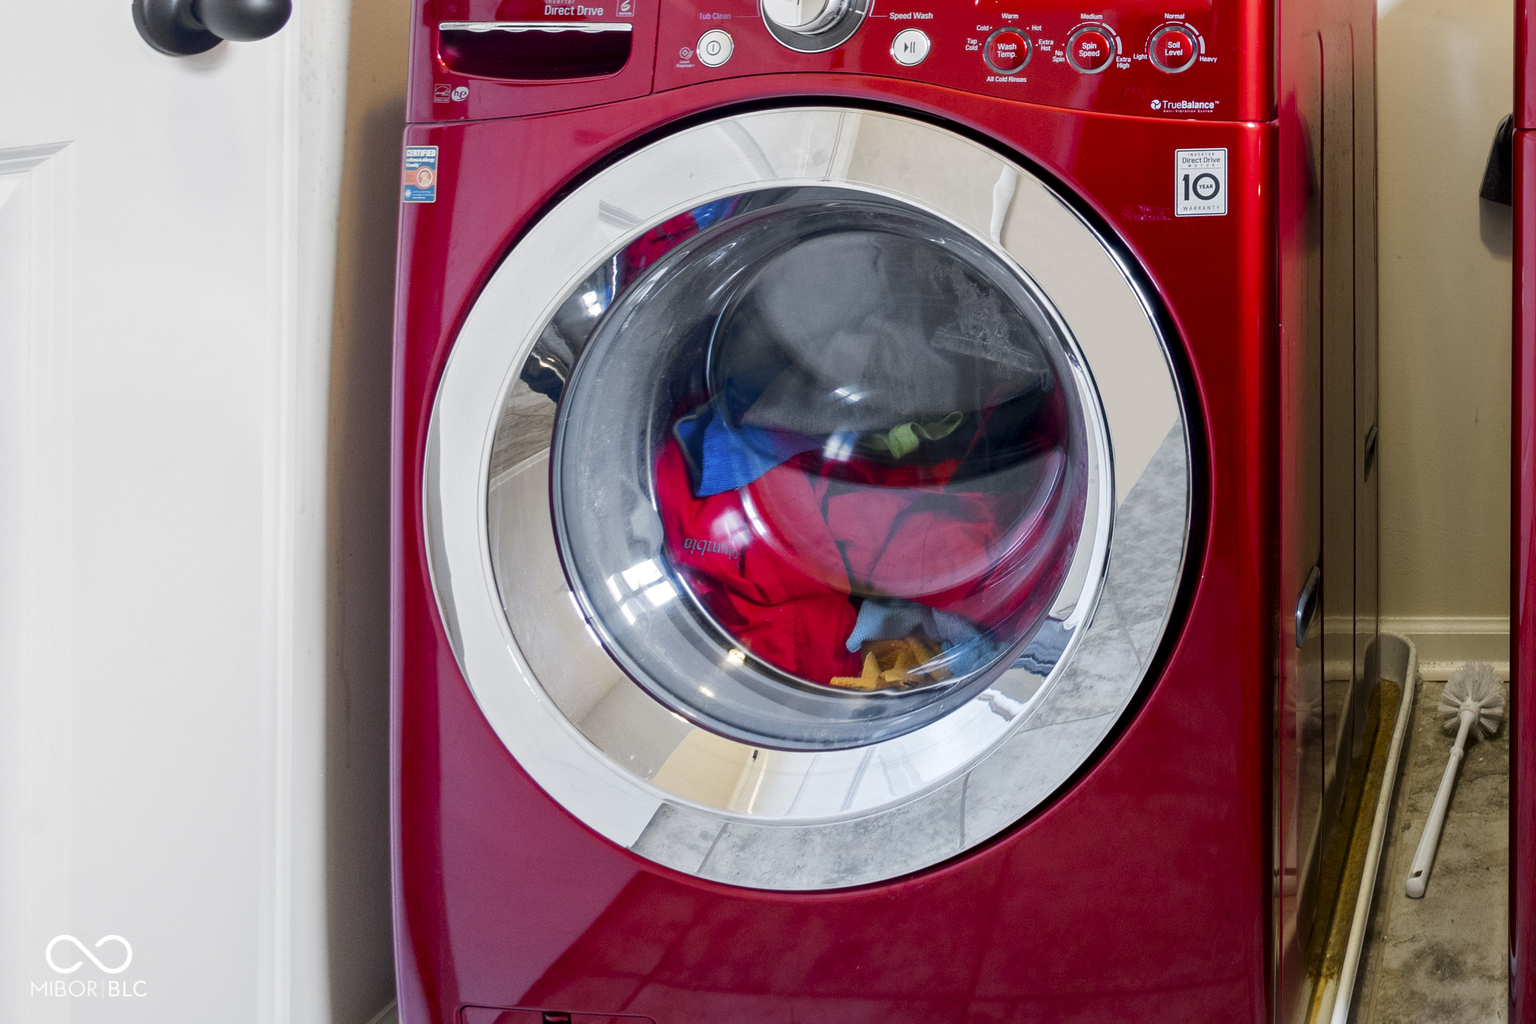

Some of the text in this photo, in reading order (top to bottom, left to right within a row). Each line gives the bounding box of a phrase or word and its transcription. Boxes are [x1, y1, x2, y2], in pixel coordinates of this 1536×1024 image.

[544, 4, 604, 16] Direct Drive
[889, 12, 912, 20] Speed
[1082, 42, 1097, 50] Spin
[1079, 50, 1100, 58] Speed
[406, 149, 436, 157] CERTIFIED
[1182, 172, 1220, 201] 10
